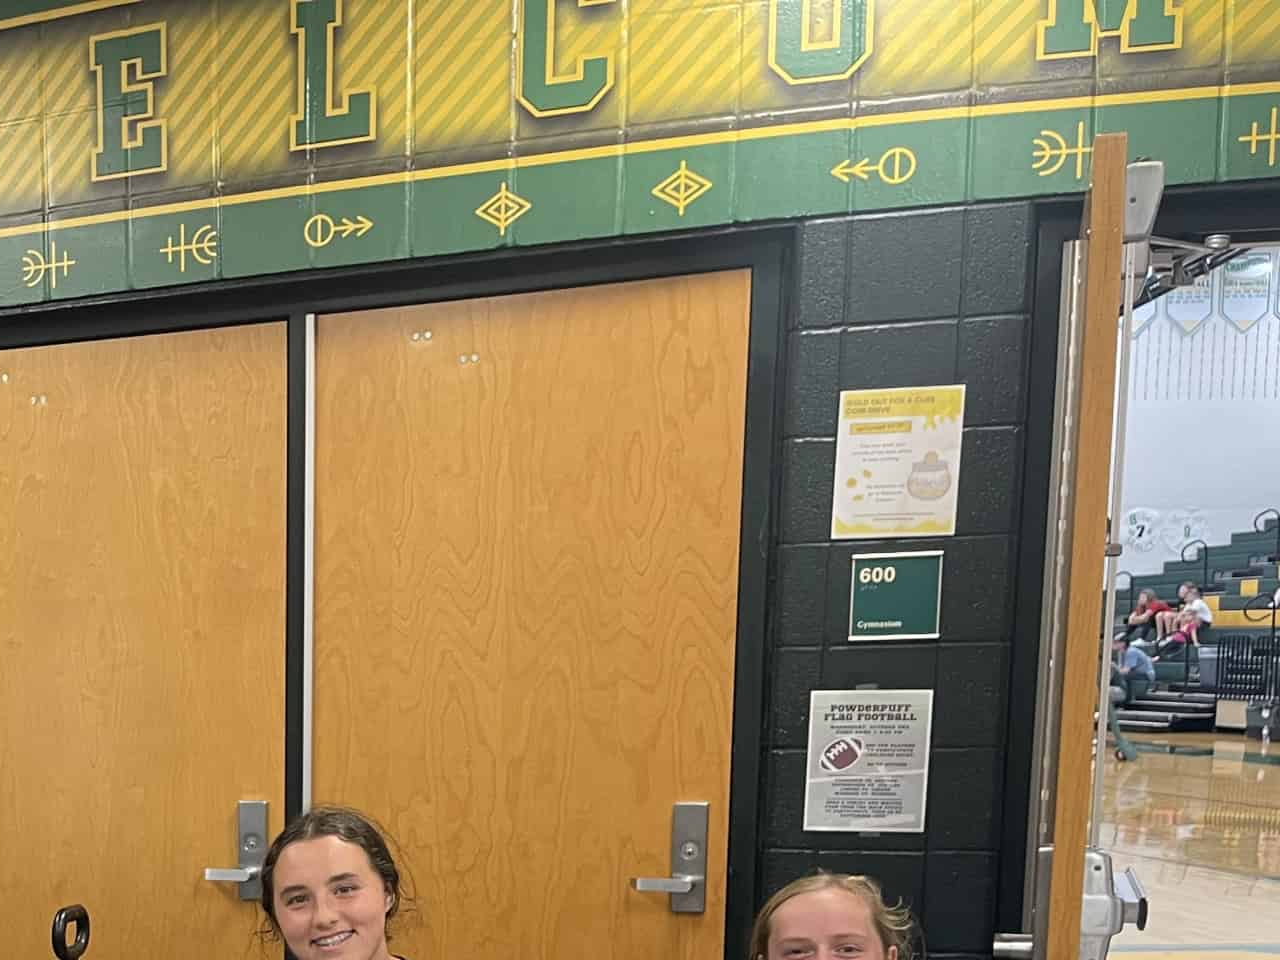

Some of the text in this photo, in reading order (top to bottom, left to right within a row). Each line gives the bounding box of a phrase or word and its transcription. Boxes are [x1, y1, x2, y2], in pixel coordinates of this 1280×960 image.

[859, 567, 896, 583] 600
[830, 704, 912, 712] POWDERPUFF
[824, 713, 917, 722] FLAG FOOTBALL
